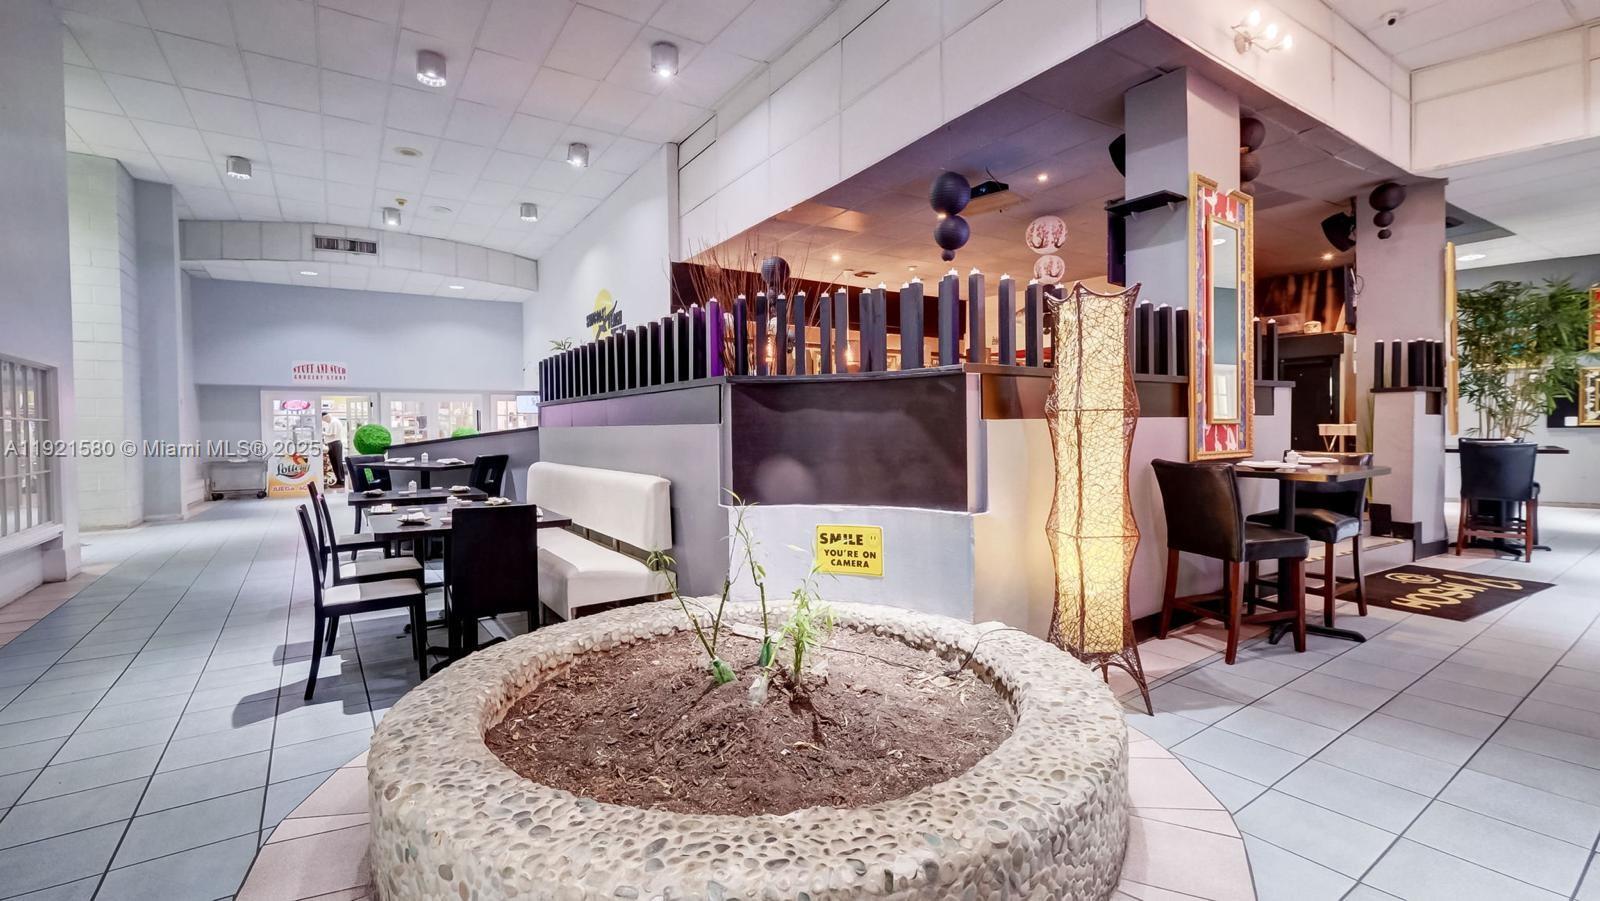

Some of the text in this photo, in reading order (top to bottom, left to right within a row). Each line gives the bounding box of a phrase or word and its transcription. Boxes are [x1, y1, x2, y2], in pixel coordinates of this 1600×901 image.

[819, 532, 864, 546] SMILE
[824, 549, 877, 559] YOU'RE ON
[830, 559, 870, 568] CAMERA
